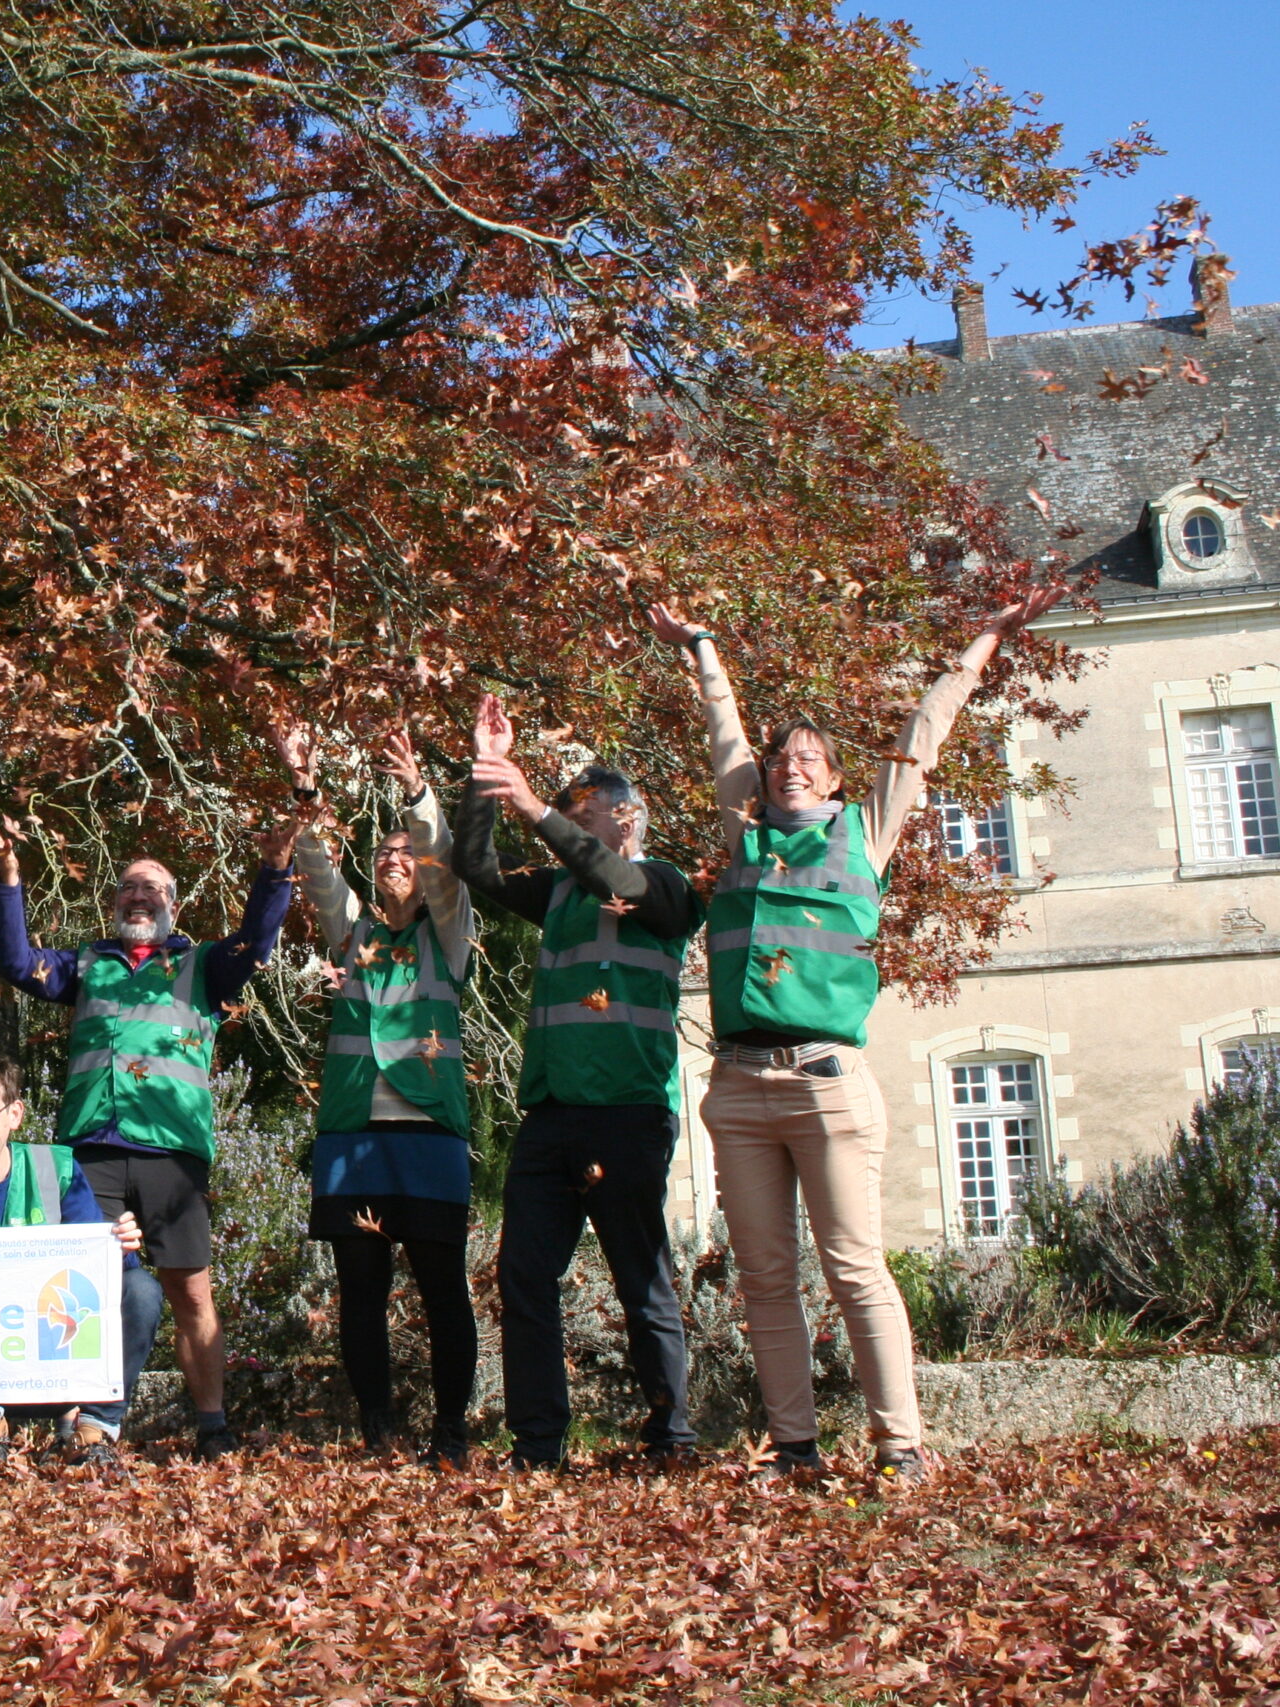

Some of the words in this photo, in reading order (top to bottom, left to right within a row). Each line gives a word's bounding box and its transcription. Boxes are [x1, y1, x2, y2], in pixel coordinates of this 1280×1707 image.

[3, 1249, 22, 1258] soin
[24, 1248, 36, 1257] de
[38, 1247, 47, 1256] la
[49, 1246, 87, 1257] Création
